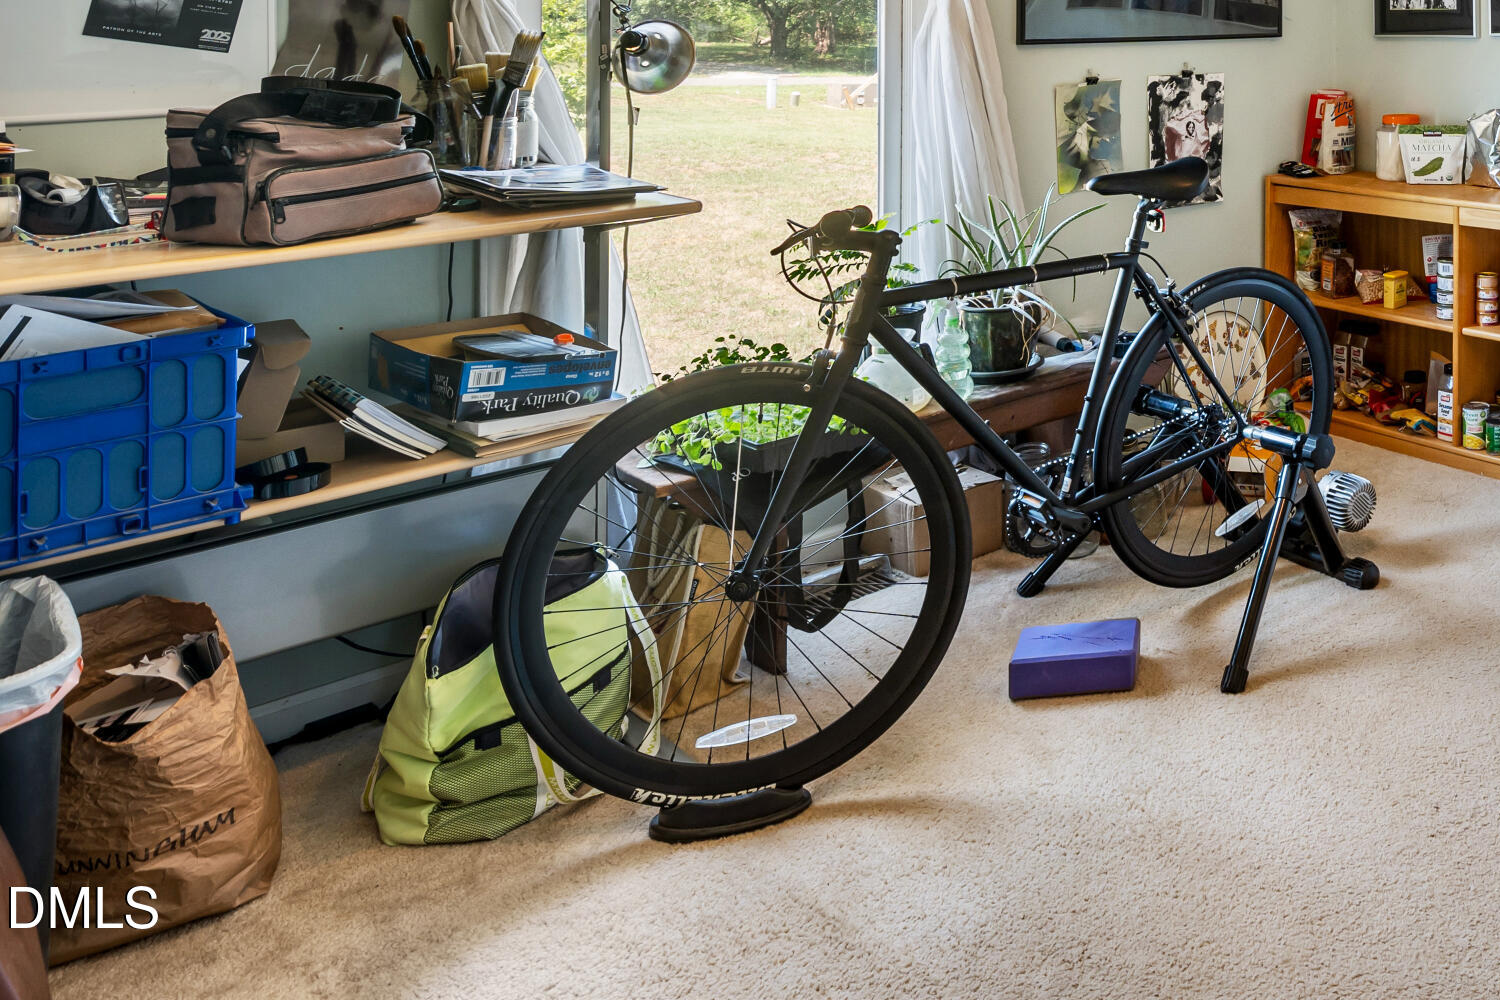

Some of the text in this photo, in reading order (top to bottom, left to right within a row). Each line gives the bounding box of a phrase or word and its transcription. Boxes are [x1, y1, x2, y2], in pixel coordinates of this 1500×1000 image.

[200, 28, 232, 41] 2025
[741, 366, 794, 374] WTB
[522, 389, 581, 409] Quality
